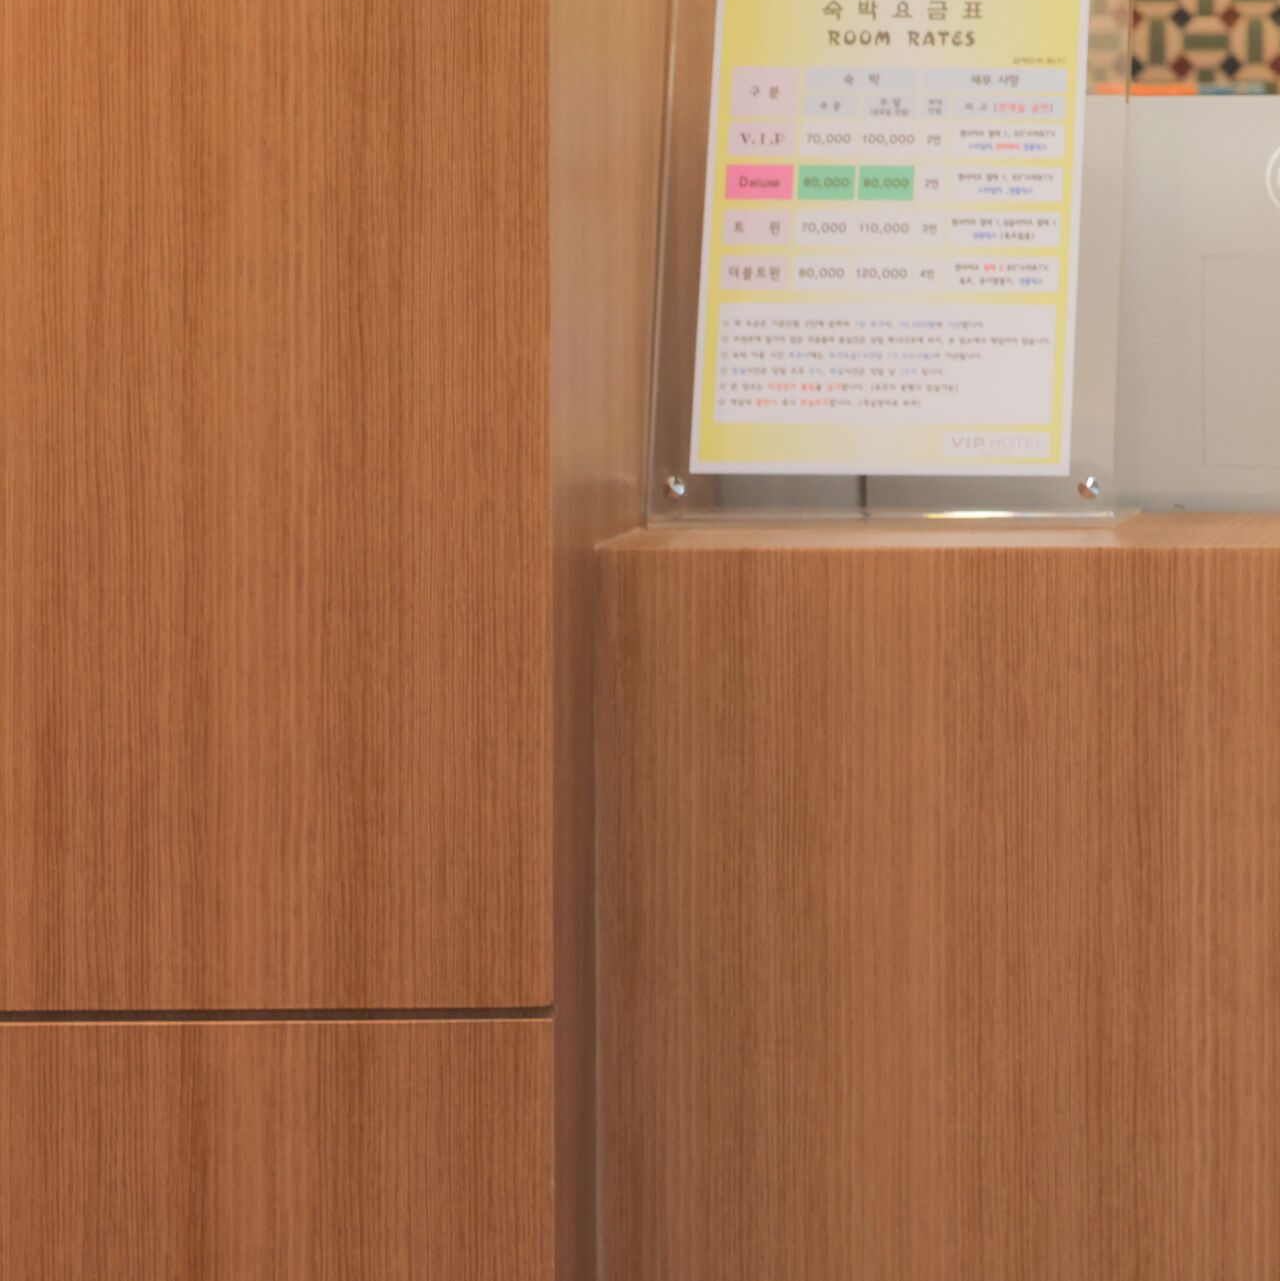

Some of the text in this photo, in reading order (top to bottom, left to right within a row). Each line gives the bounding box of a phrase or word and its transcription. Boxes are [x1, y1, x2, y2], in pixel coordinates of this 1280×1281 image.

[827, 29, 977, 47] ROOM RATES
[806, 132, 852, 147] 70,000
[861, 132, 916, 148] 100,000
[801, 221, 848, 235] 70,000
[858, 222, 910, 236] 110,000
[797, 266, 846, 280] 80,000
[856, 267, 909, 281] 120,000
[951, 436, 1045, 449] VIP HOTEL
